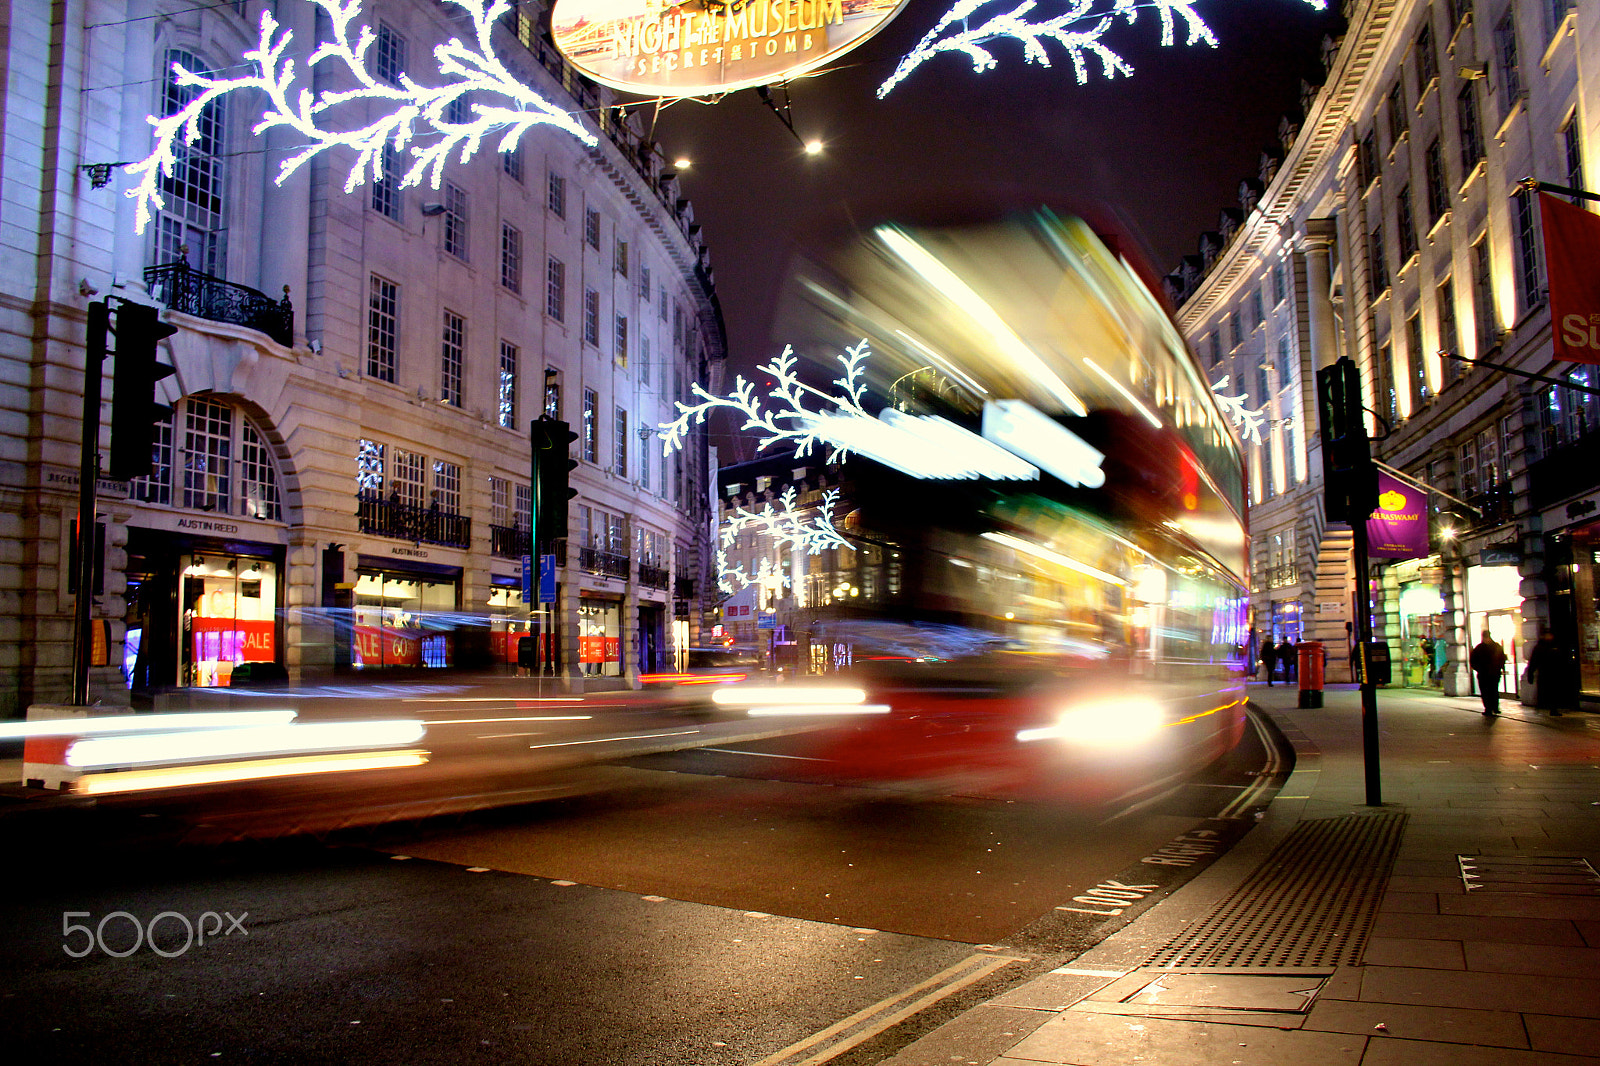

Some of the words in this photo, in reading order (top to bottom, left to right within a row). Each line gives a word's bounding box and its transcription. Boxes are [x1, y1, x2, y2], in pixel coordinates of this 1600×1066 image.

[701, 8, 719, 26] AT
[724, 0, 844, 42] MUSEUM
[611, 12, 697, 60] NIGHT
[696, 25, 719, 45] THE
[637, 47, 723, 76] SECRET
[750, 33, 813, 58] TOMB
[48, 473, 80, 484] REGEN
[178, 519, 212, 530] AUSTIN
[214, 523, 238, 533] REED
[353, 634, 379, 657] ALE
[1054, 880, 1159, 916] LOOK
